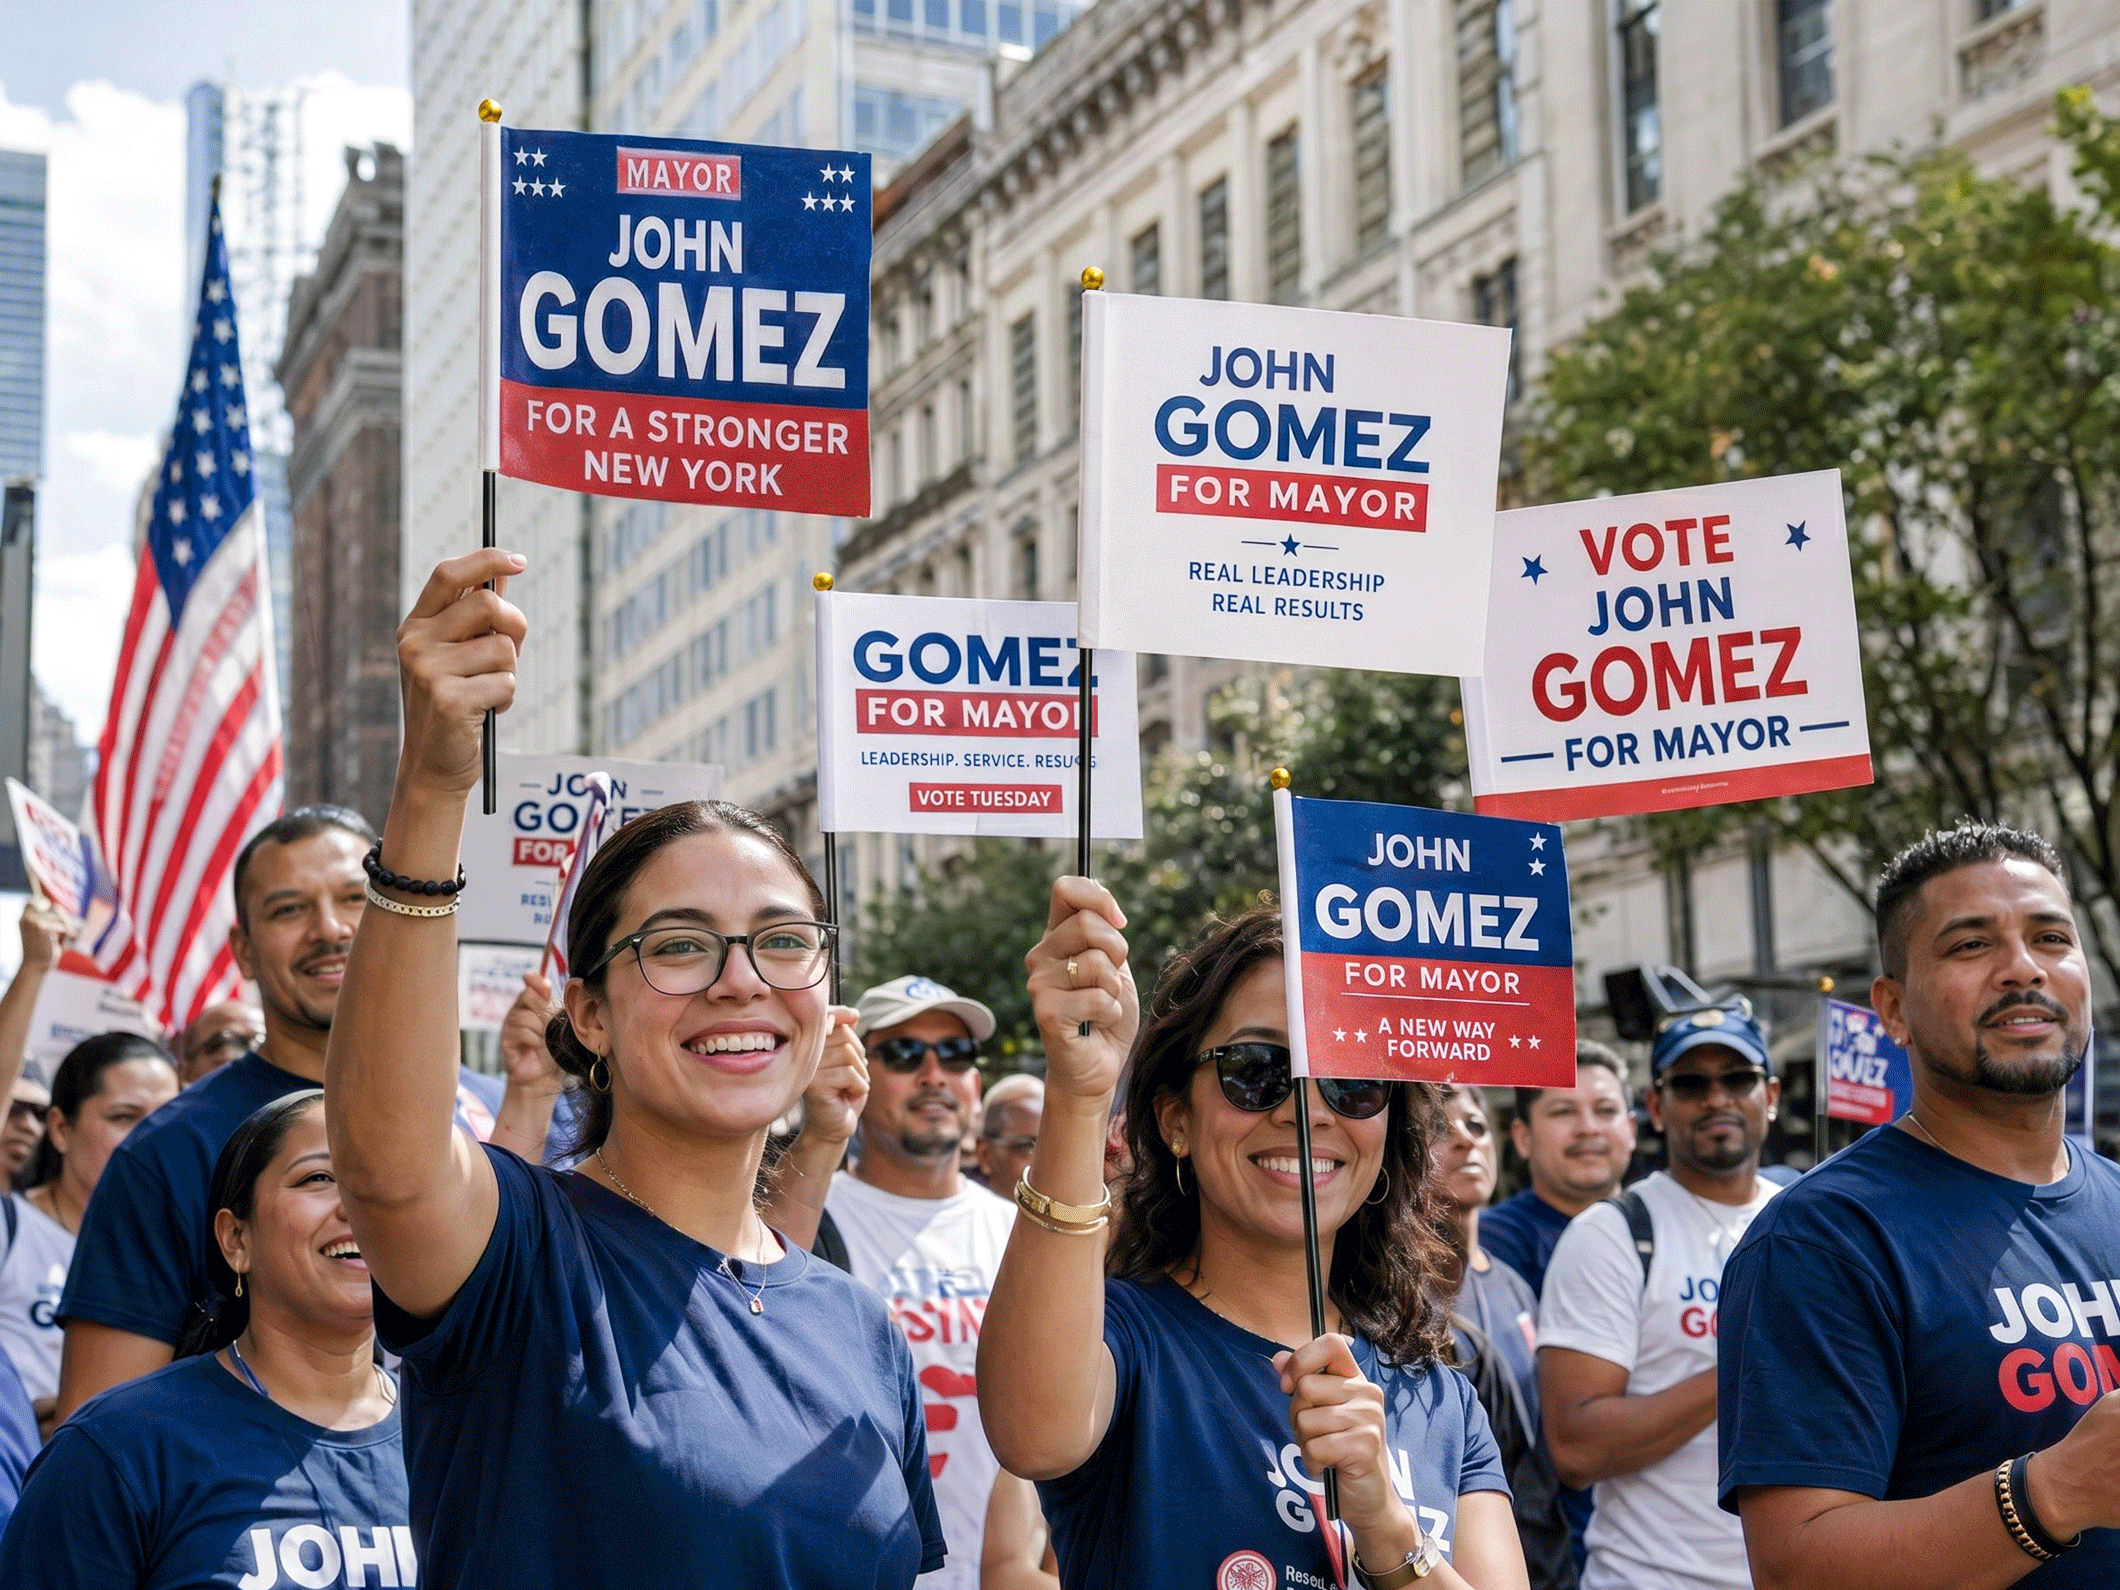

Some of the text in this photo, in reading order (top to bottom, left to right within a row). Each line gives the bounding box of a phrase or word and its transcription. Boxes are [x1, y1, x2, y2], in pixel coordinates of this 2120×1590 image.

[626, 158, 732, 194] MAYOR
[608, 214, 743, 274] JOHN
[519, 270, 846, 389] GOMEZ
[1199, 345, 1335, 393] JOHN
[527, 399, 849, 455] FOR A STRONGER
[1154, 395, 1431, 474] GOMEZ
[584, 449, 783, 496] NEW YORK
[1170, 474, 1416, 521] FOR MAYOR
[1579, 514, 1734, 576] VOTE
[1189, 562, 1385, 593] REAL LEADERSHIP
[1212, 593, 1364, 621] REAL RESULTS
[1587, 577, 1735, 636] JOHN
[1532, 626, 1809, 723] GOMEZ
[868, 697, 1080, 730] FOR MAYO
[861, 751, 958, 767] LEADERSHIP.
[964, 753, 1030, 768] SERVICE.
[1565, 715, 1791, 771] FOR MAYOR
[548, 773, 627, 800] JON
[917, 789, 1051, 807] VOTE TUESDAY
[1367, 832, 1471, 872] JOHN
[1315, 883, 1540, 952] GOMEZ
[1345, 961, 1520, 995] FOR MAYOR
[1378, 1017, 1496, 1039] A NEW WAY
[1387, 1039, 1491, 1061] FORWARD
[1989, 1279, 2120, 1344] JOH
